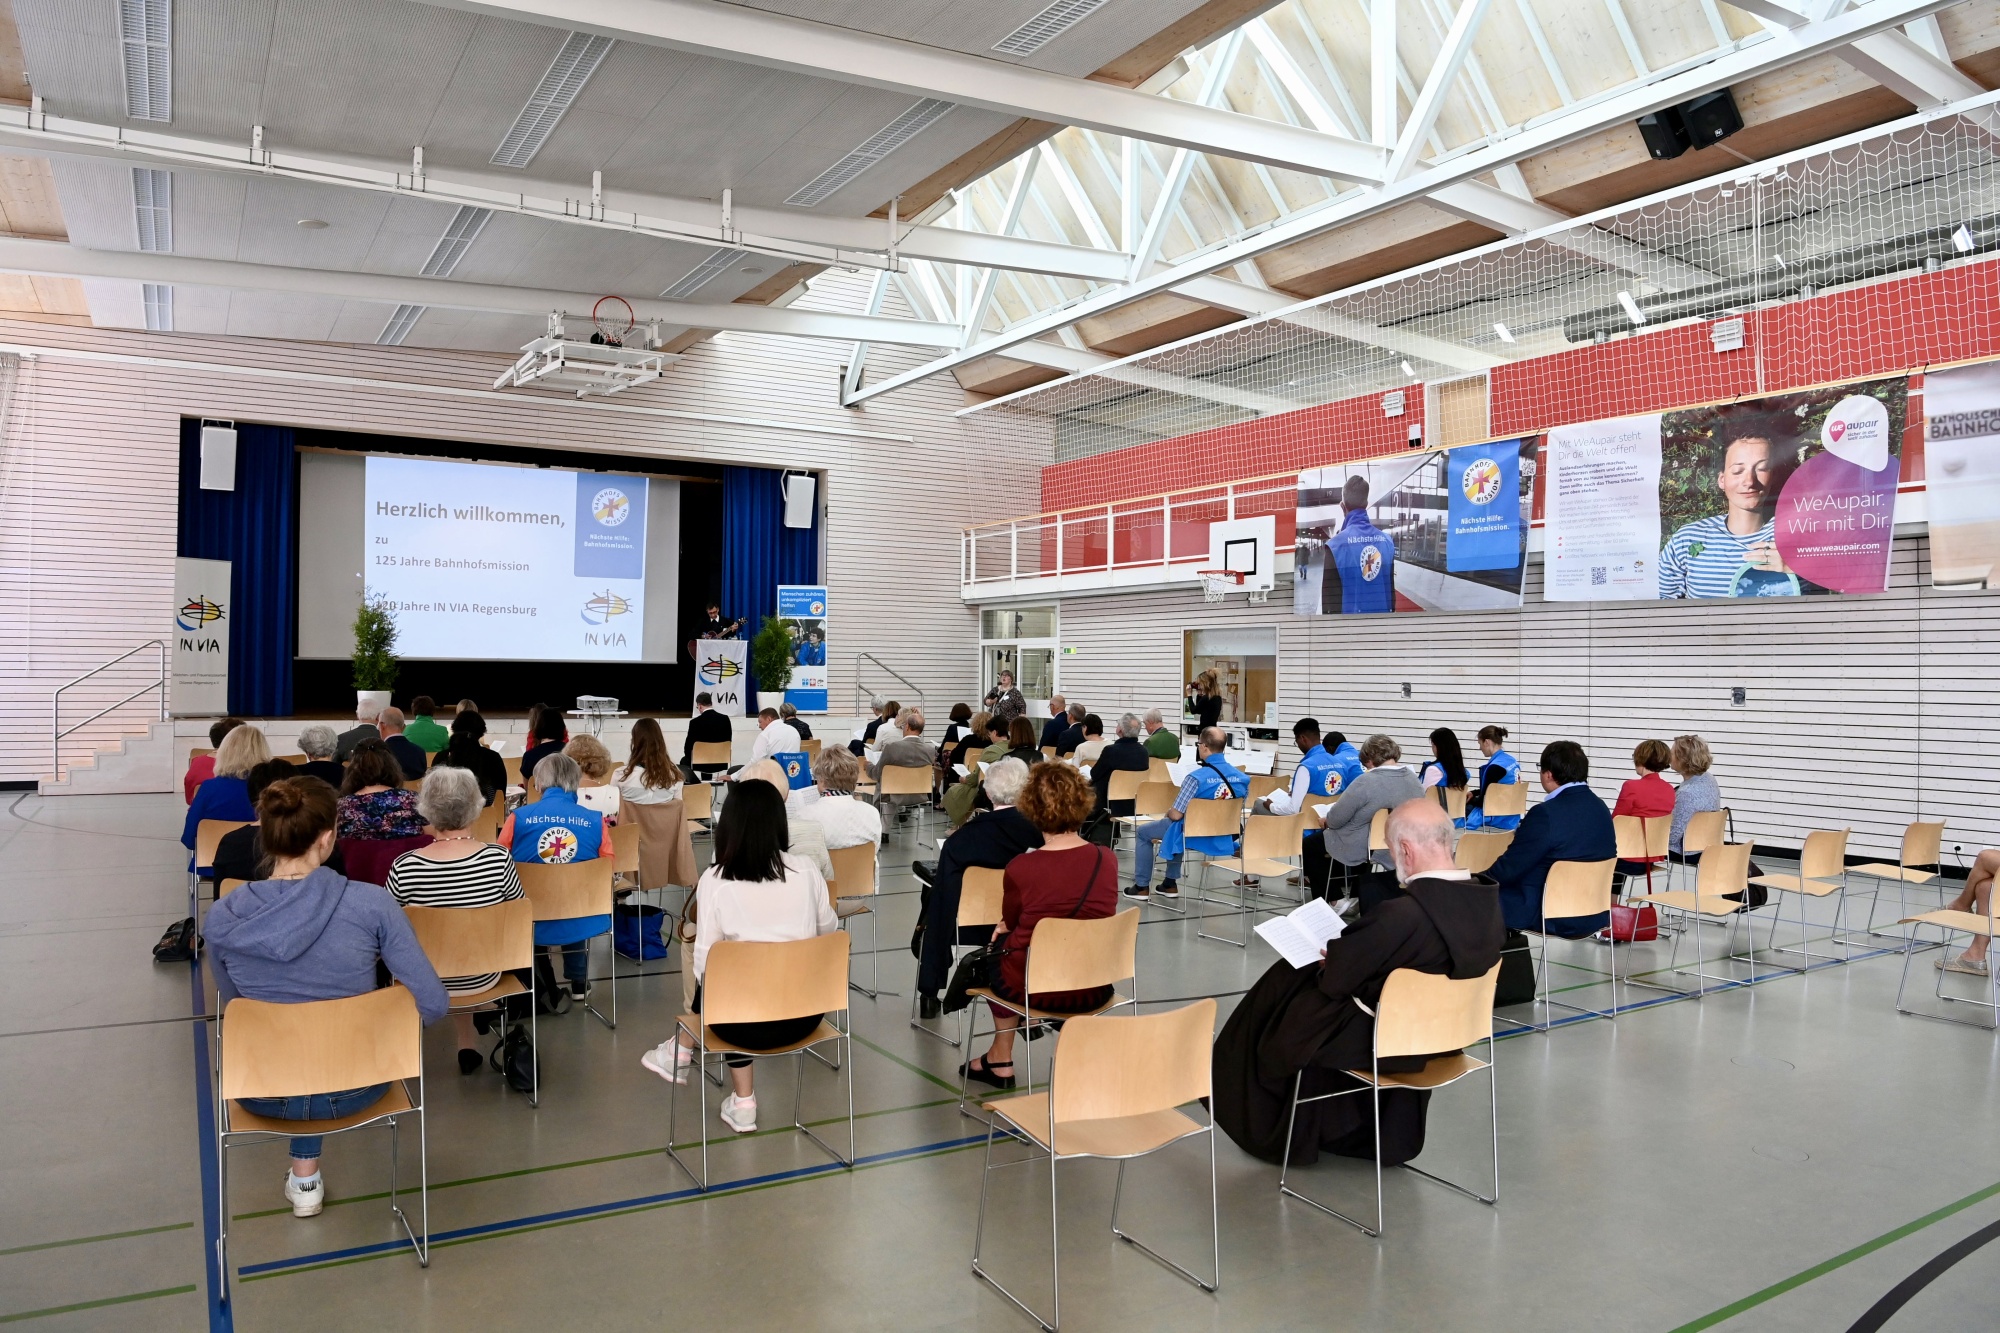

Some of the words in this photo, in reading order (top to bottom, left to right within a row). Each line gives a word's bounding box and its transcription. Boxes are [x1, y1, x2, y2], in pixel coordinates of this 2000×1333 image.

[1930, 408, 2000, 424] KATHOLISCH
[1831, 424, 1844, 432] we
[1846, 419, 1879, 430] aupair
[1558, 440, 1571, 450] Mit
[1574, 435, 1616, 448] WeAupair
[1619, 432, 1642, 442] steht
[1558, 452, 1570, 460] Dir
[1572, 450, 1584, 458] die
[1586, 448, 1608, 457] Welt
[1610, 444, 1637, 454] offen!
[1464, 462, 1492, 488] BAHNHOFS
[1476, 480, 1499, 502] MISSION
[594, 490, 620, 510] BAHNHOFS
[1794, 490, 1886, 512] WeAupair.
[376, 501, 448, 519] Herzlich
[454, 506, 566, 528] willkommen,
[605, 508, 628, 525] MISSION
[1461, 515, 1486, 524] Nächste
[1486, 514, 1504, 522] Hilfe:
[1456, 524, 1510, 534] Bahnhofsmission.
[1788, 518, 1820, 534] Wir
[1826, 514, 1855, 531] mit
[1862, 512, 1890, 530] Dir.
[375, 536, 388, 545] zu
[584, 541, 634, 550] Bahnhofsmission.
[614, 534, 630, 542] Hilfe:
[1348, 536, 1372, 544] Nächste
[1797, 543, 1880, 554] www.weaupair.com
[375, 556, 396, 566] 125
[400, 556, 431, 568] Jahre
[434, 558, 530, 572] Bahnhofsmission
[399, 602, 430, 612] Jahre
[434, 602, 446, 612] IN
[450, 603, 469, 613] VIA
[472, 604, 537, 617] Regensburg
[180, 638, 193, 652] IN
[198, 638, 220, 654] VIA
[584, 632, 598, 646] IN
[603, 632, 628, 648] VIA
[716, 692, 738, 706] VIA
[526, 815, 566, 824] Nächste
[568, 816, 592, 828] Hilfe:
[540, 828, 568, 850] BAHNHOFS
[550, 848, 576, 864] MISSION
